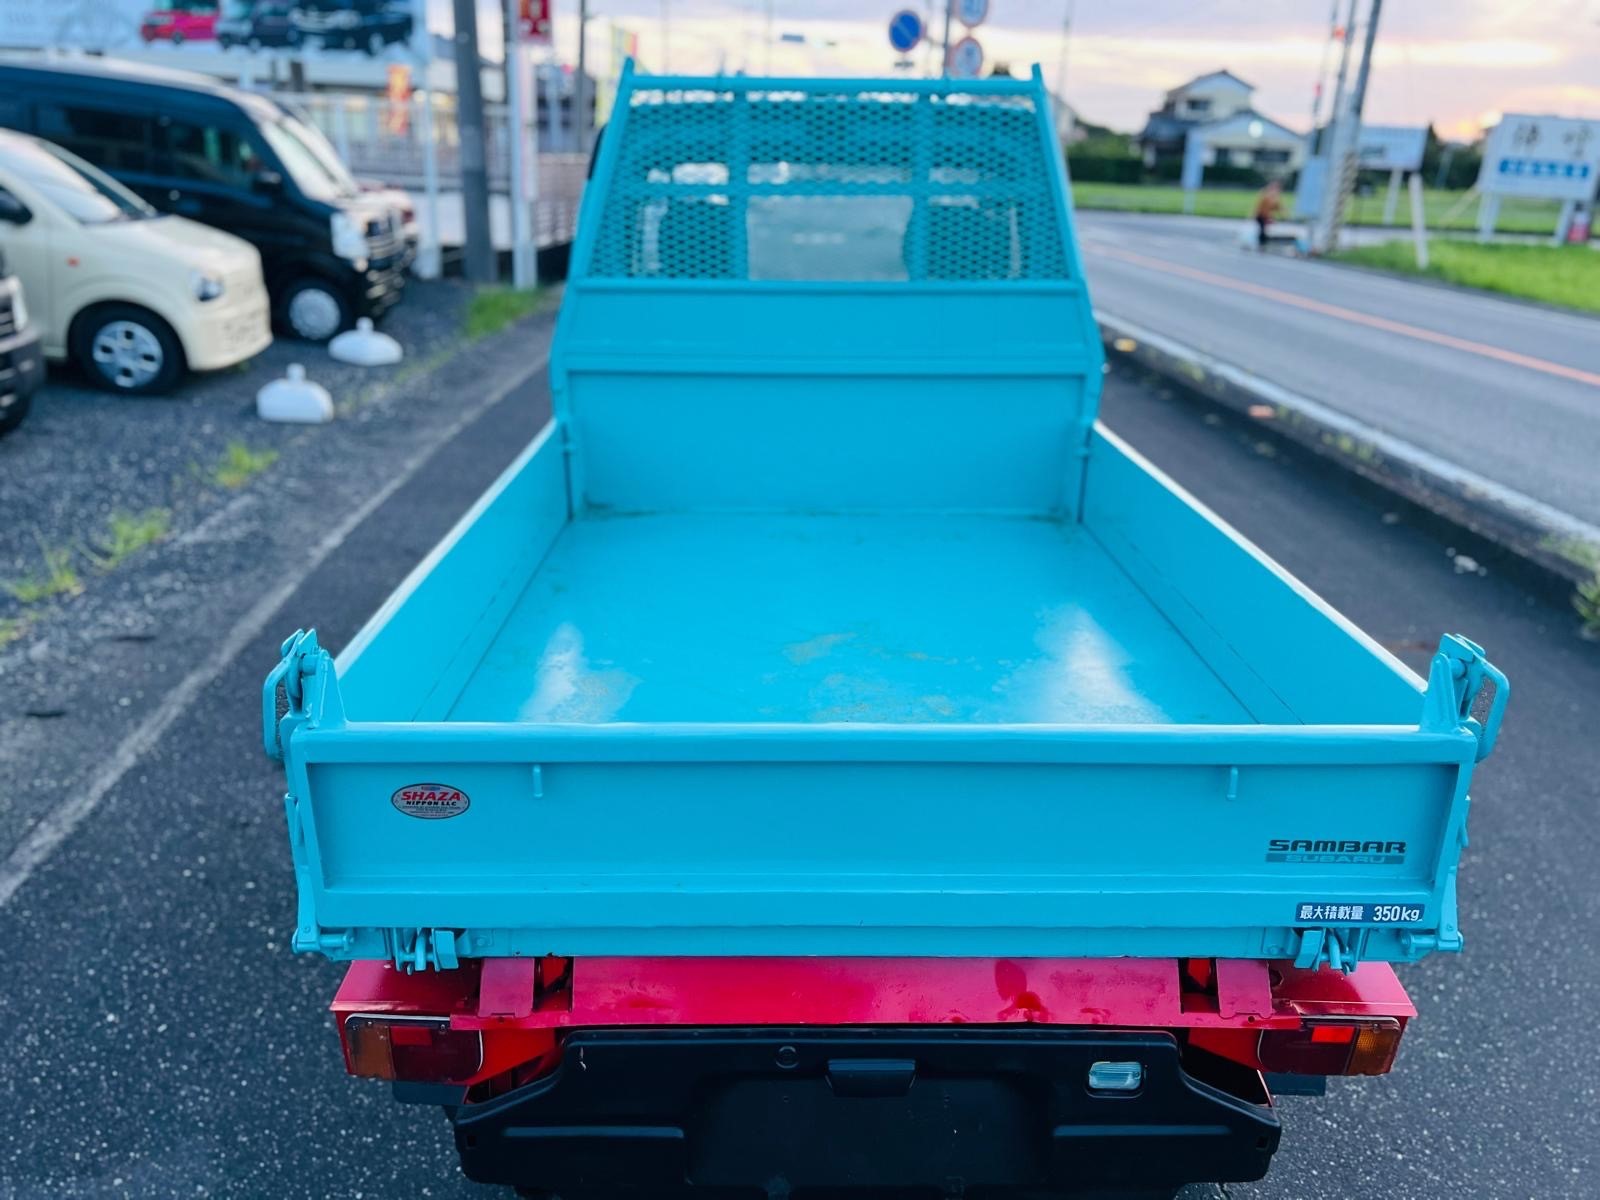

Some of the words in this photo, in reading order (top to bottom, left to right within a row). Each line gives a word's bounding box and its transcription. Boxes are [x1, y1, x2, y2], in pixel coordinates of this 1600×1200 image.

[402, 791, 461, 801] SHAZA
[1268, 839, 1407, 854] SAMBAR
[1285, 854, 1386, 863] SUBARU
[1299, 905, 1364, 920] 最大積載量
[1373, 906, 1420, 922] 350kg
